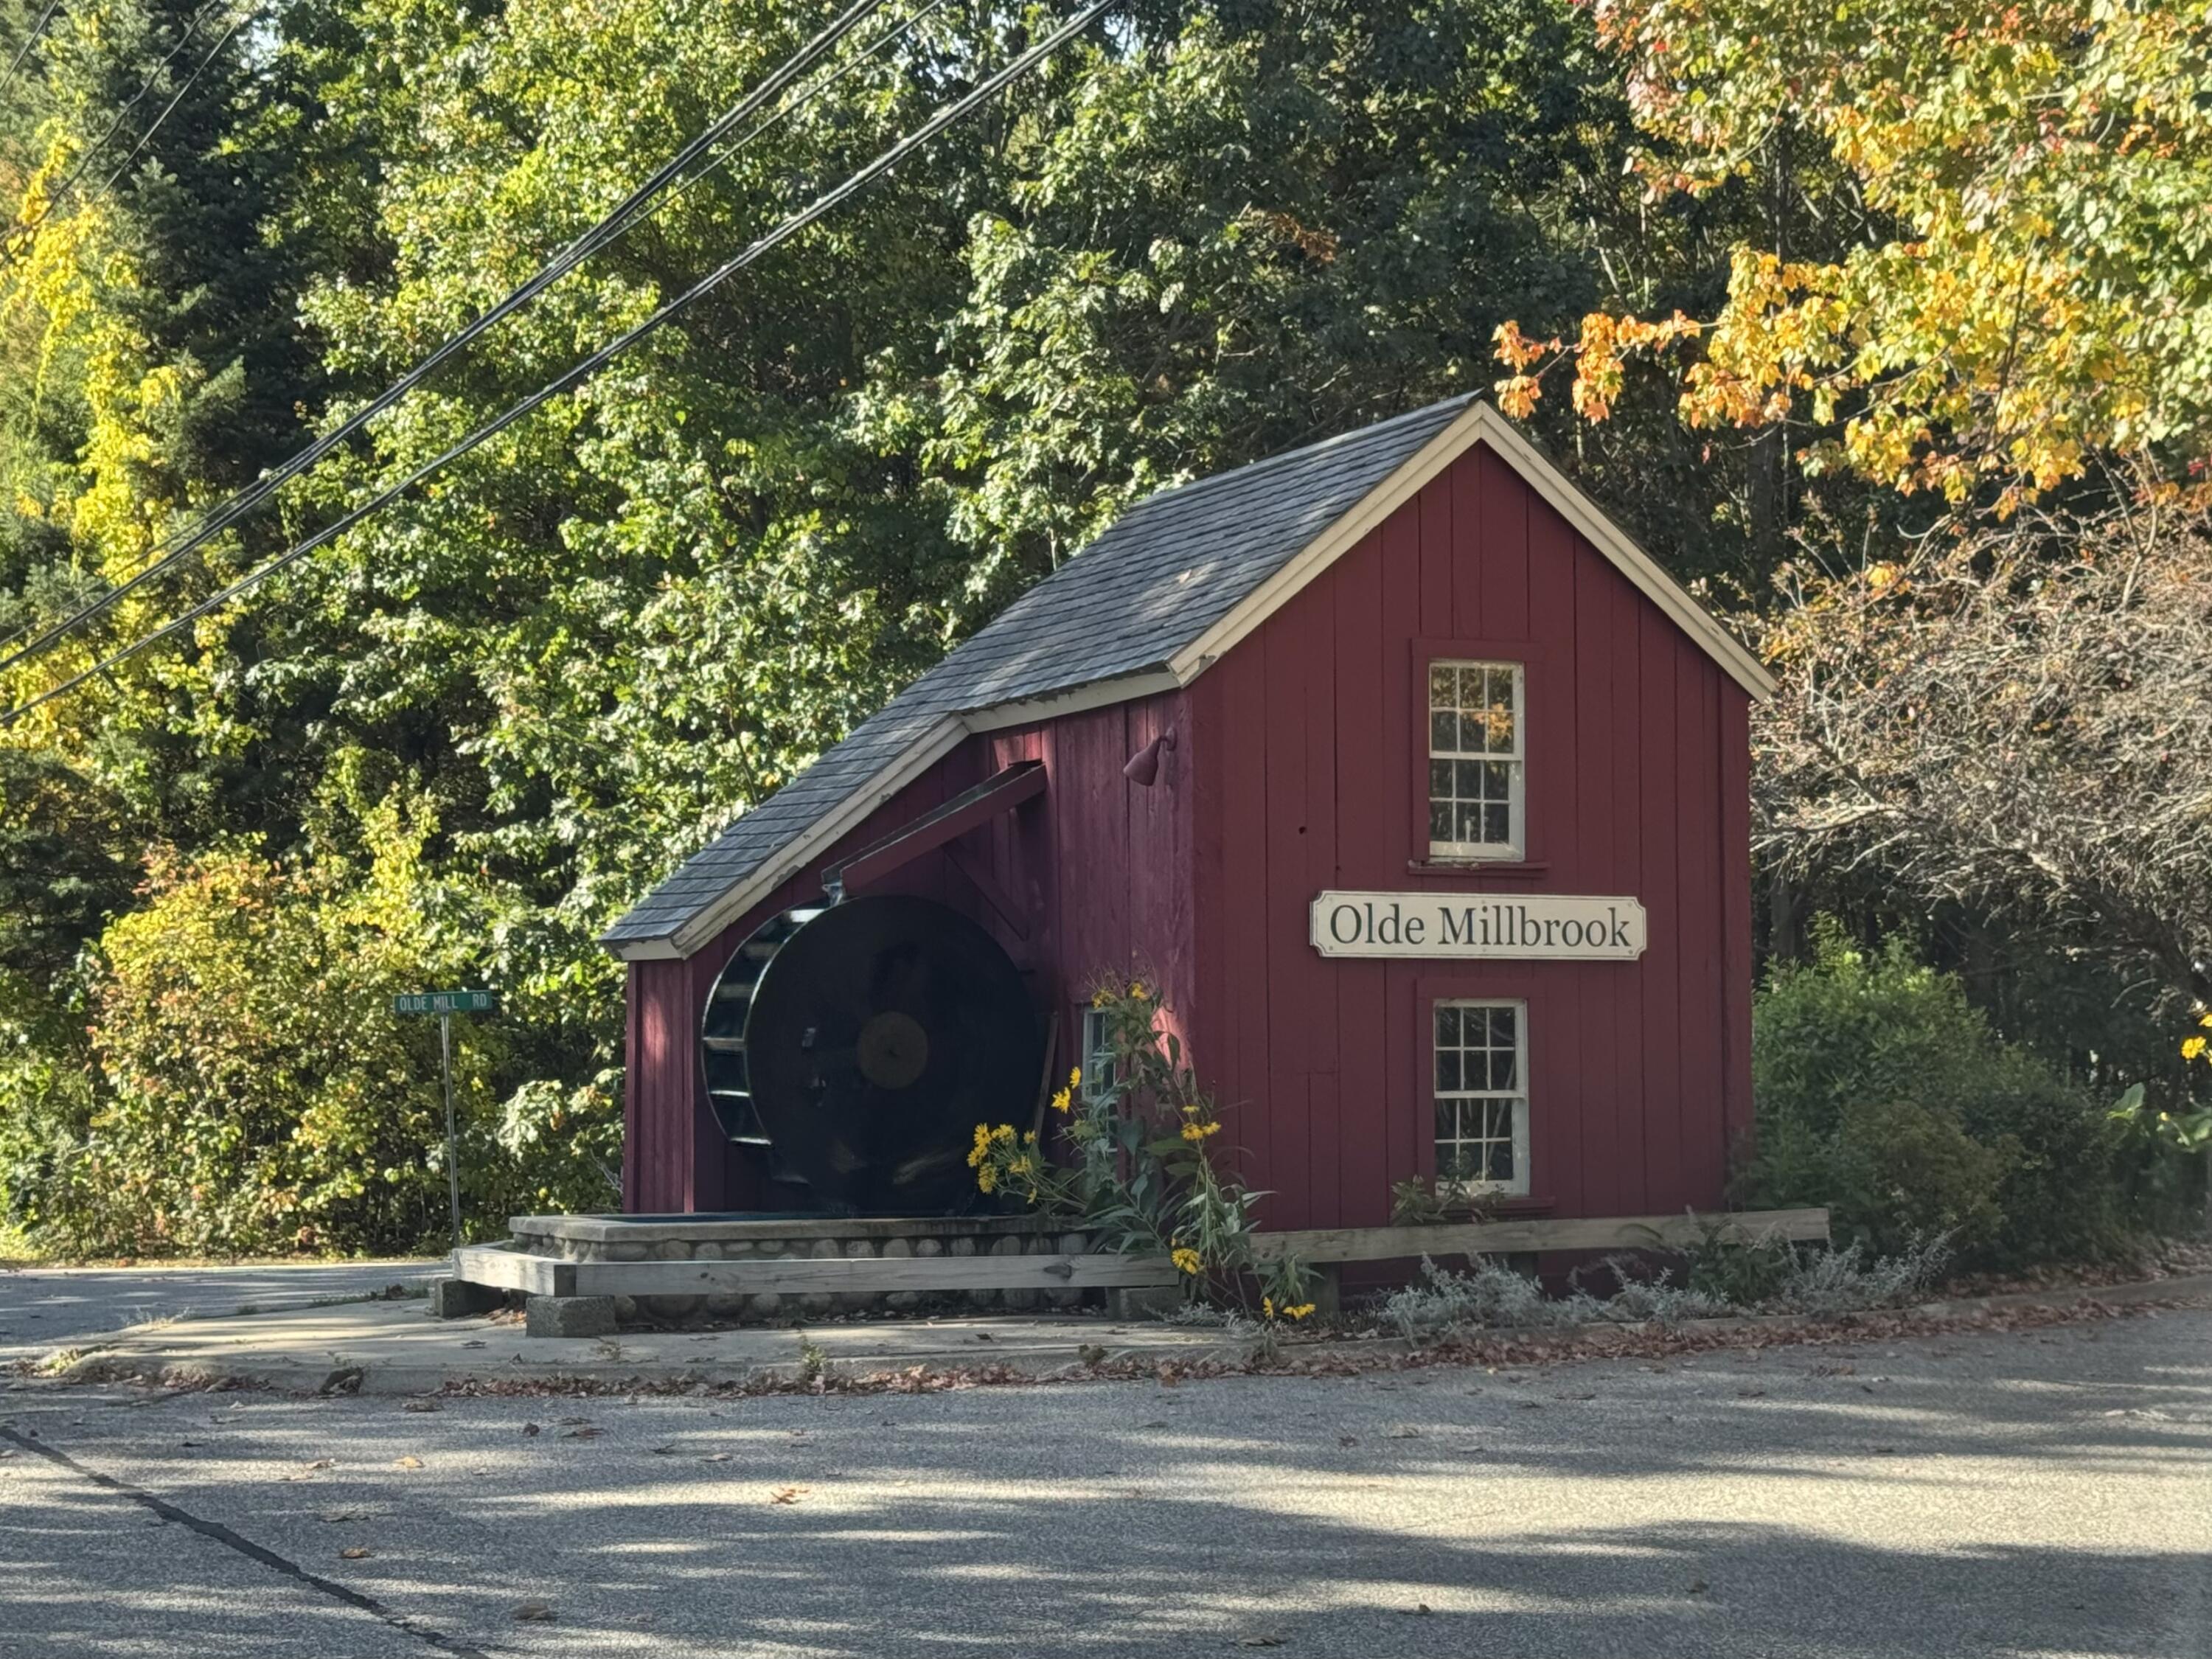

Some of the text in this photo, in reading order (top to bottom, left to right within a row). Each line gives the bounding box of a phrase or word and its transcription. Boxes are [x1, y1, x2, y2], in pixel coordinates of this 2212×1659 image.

[1329, 902, 1632, 947] Olde Millbrook
[399, 993, 487, 1011] OLDE MILL RD
